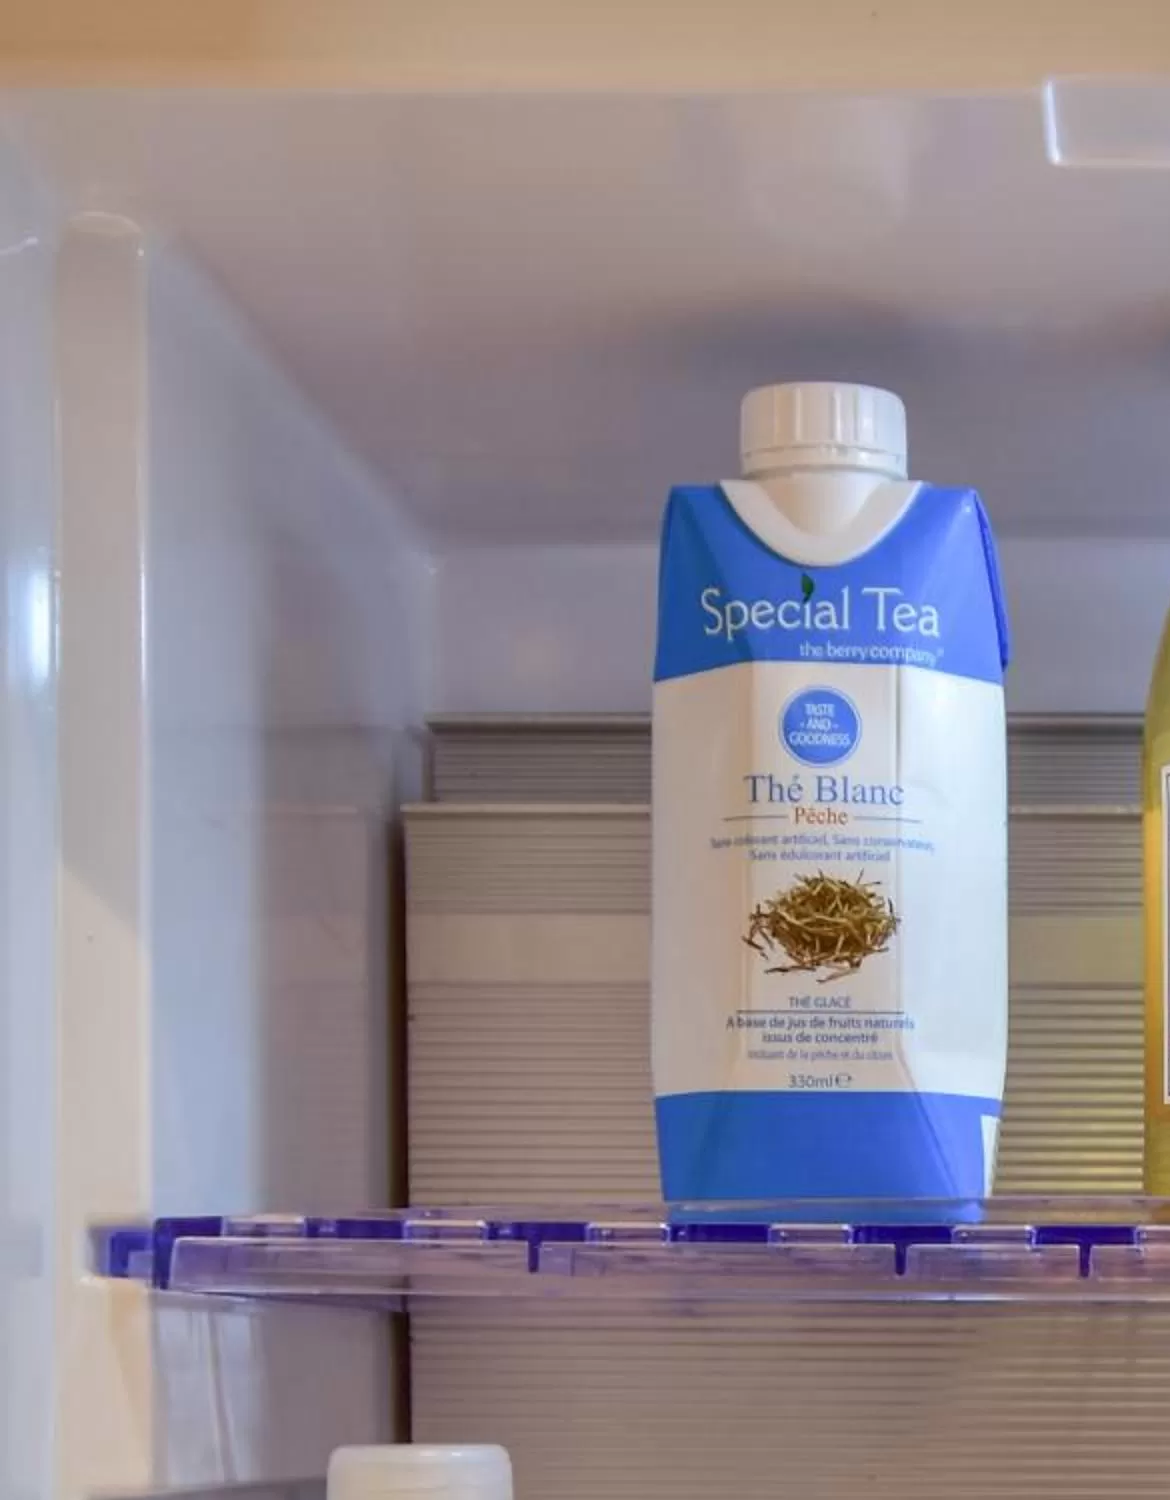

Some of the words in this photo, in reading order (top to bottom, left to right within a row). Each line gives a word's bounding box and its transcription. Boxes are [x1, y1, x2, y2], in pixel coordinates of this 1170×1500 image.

[701, 584, 850, 643] Special
[861, 586, 941, 638] Tea
[799, 641, 825, 657] the
[827, 641, 866, 661] berry
[743, 774, 804, 805] Thé
[816, 774, 905, 806] Blanc
[794, 806, 849, 826] Pêche
[769, 1016, 786, 1030] de
[786, 1017, 807, 1031] jus
[809, 1016, 826, 1030] de
[828, 1016, 862, 1030] fruits
[796, 1031, 812, 1044] de
[815, 1031, 879, 1044] concentré
